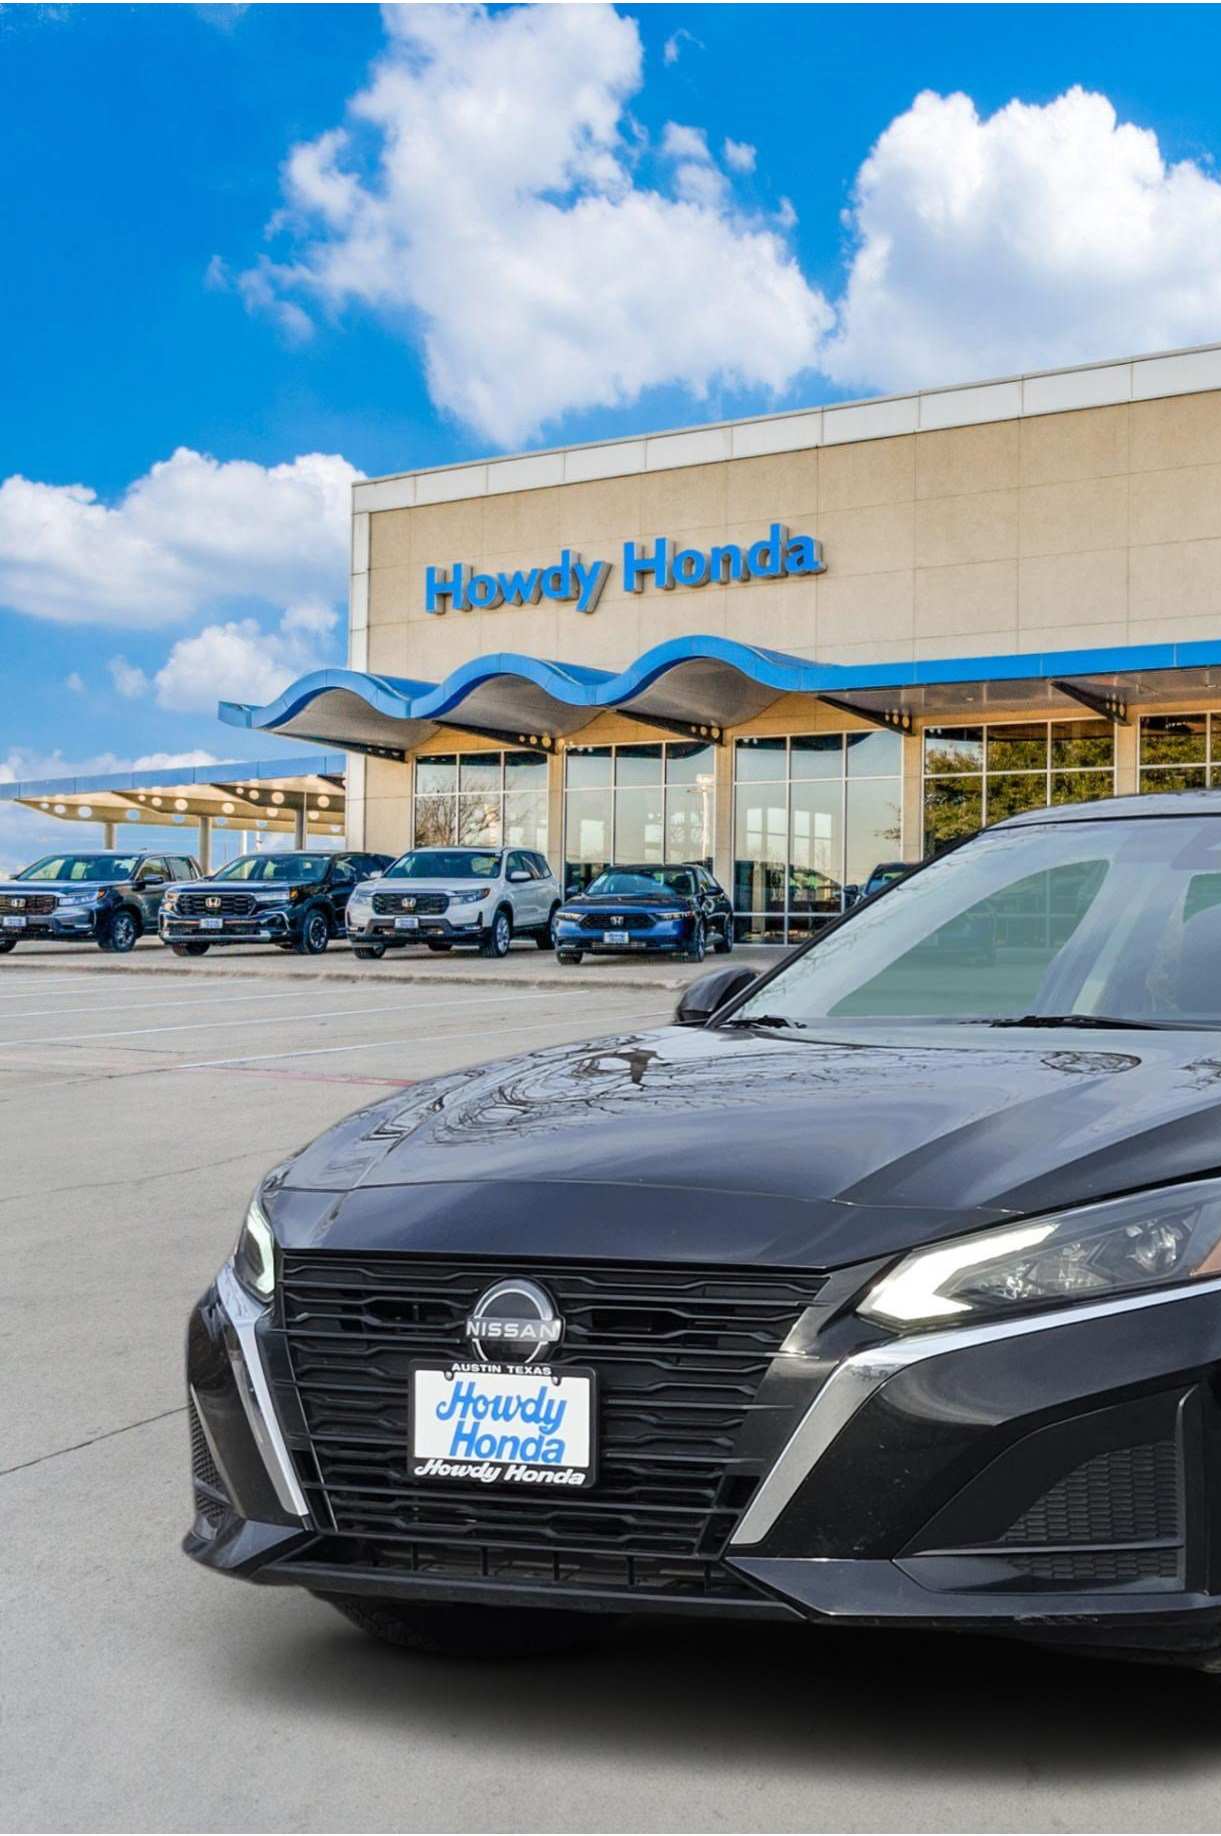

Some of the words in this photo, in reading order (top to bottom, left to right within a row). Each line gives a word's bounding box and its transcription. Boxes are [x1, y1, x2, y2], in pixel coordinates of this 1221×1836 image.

[425, 549, 612, 614] Howdy
[623, 523, 827, 593] Honda
[466, 1320, 558, 1339] NISSAN
[451, 1363, 502, 1374] AUSTIN
[507, 1364, 552, 1376] TEXAS
[436, 1381, 568, 1435] Howdy
[449, 1420, 566, 1464] Honda
[414, 1458, 502, 1482] Howdy
[503, 1464, 586, 1485] Honda
